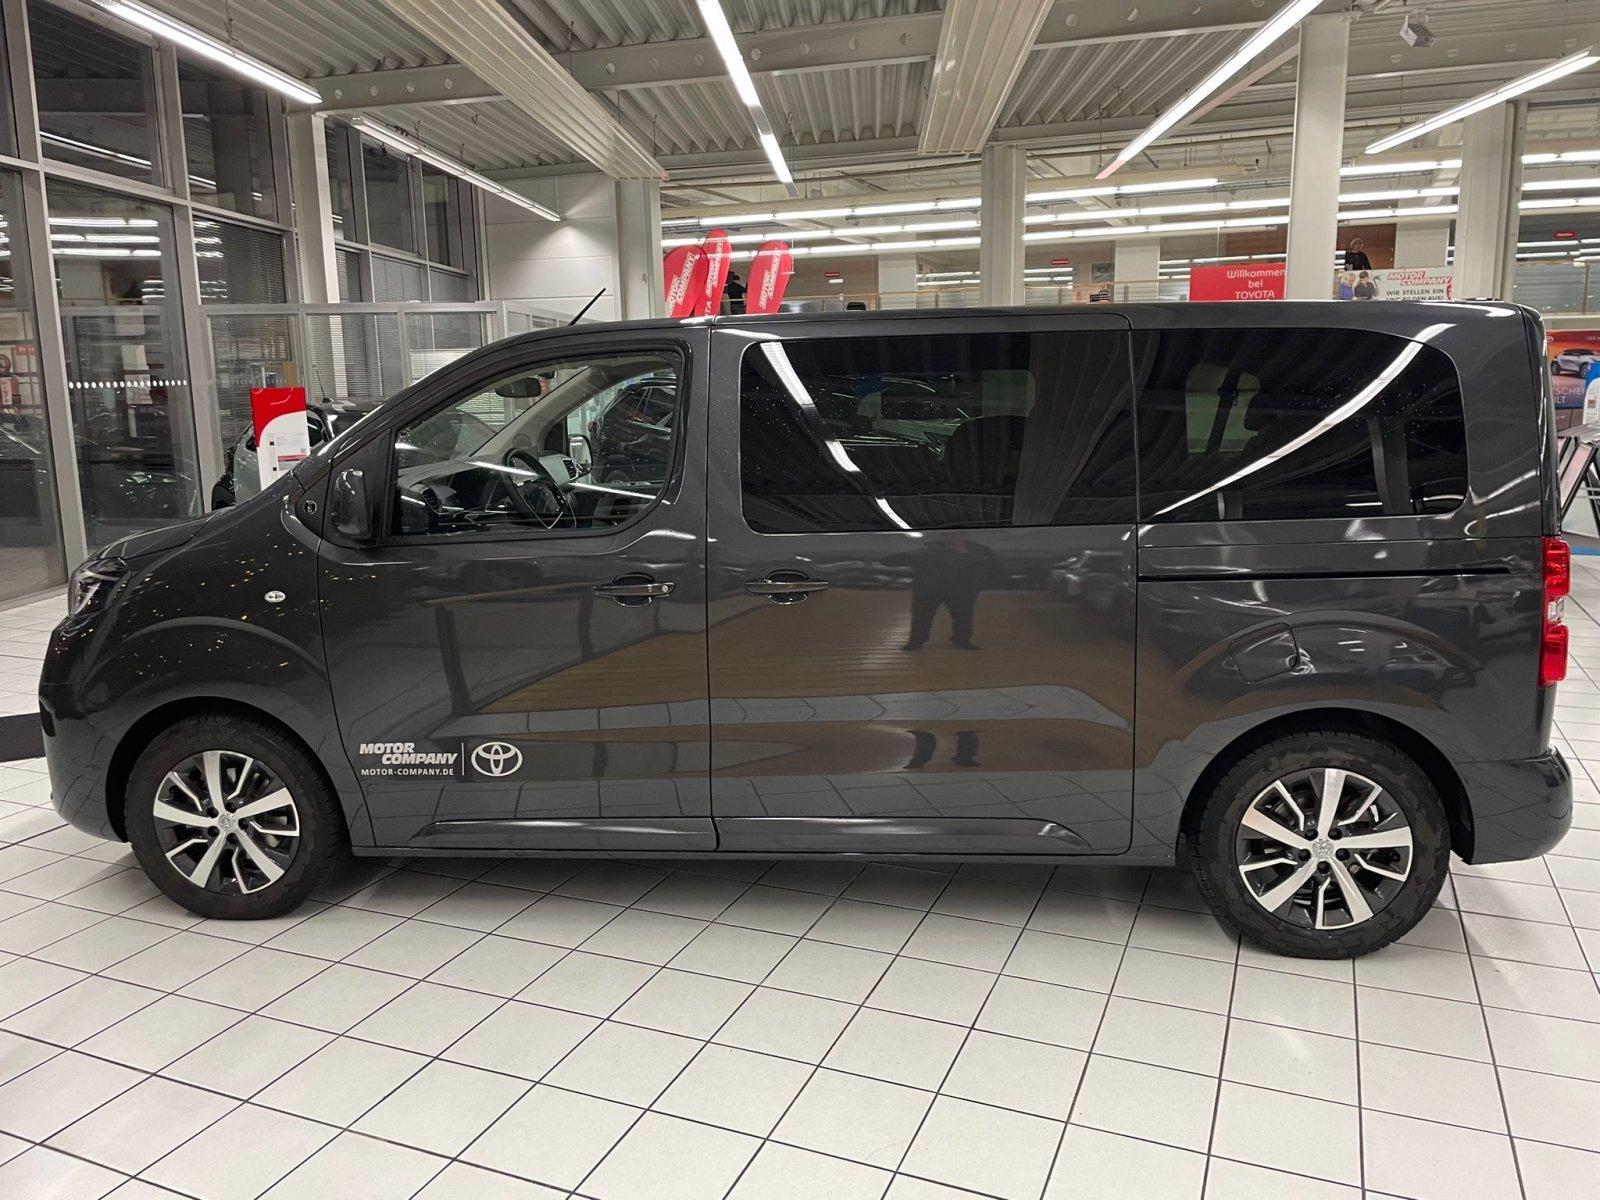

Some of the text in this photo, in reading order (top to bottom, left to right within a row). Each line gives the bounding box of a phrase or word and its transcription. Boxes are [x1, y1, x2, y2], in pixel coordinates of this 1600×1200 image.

[676, 251, 696, 305] COMPANY
[768, 248, 782, 300] COMPANY
[1227, 269, 1287, 279] Willkommen
[1388, 271, 1425, 280] MOTOR
[1248, 279, 1263, 288] bei
[1400, 276, 1453, 286] COMPANY
[758, 269, 771, 310] MOTOR
[1235, 290, 1275, 299] TOYOTA
[359, 742, 415, 754] MOTOR
[382, 752, 458, 765] COMPANY
[361, 768, 454, 776] MOTOR-COMPANY.DE
